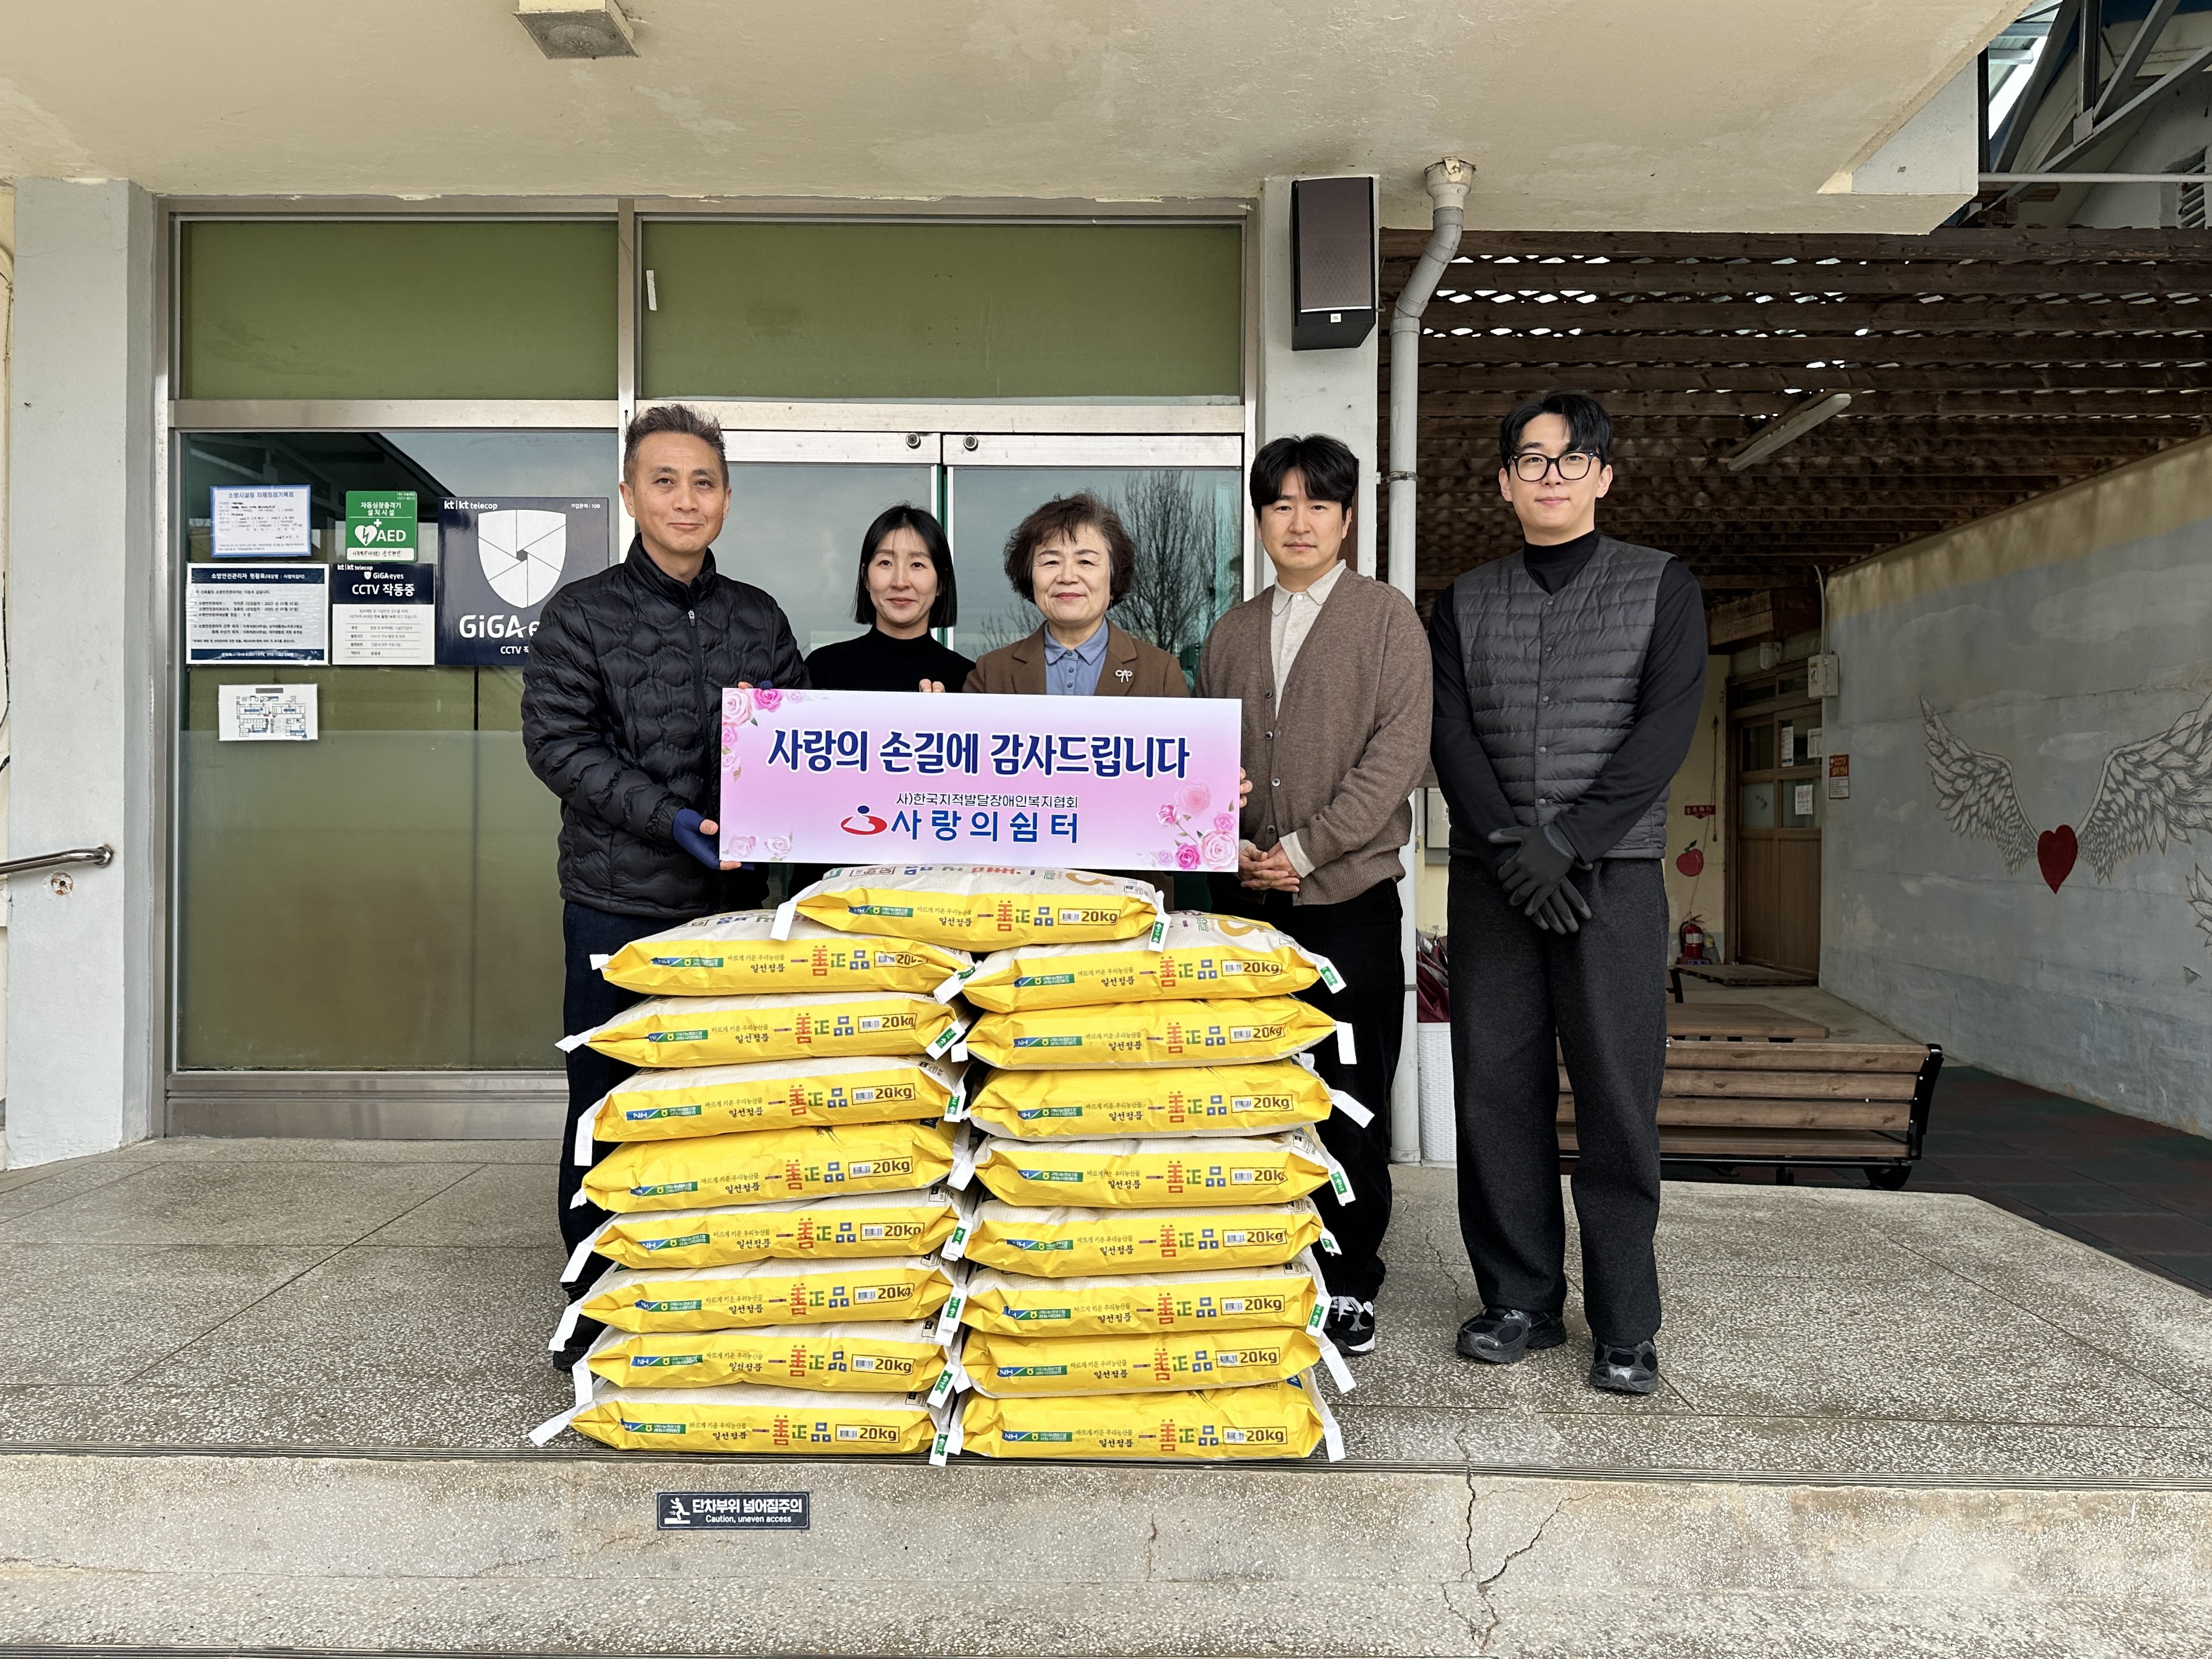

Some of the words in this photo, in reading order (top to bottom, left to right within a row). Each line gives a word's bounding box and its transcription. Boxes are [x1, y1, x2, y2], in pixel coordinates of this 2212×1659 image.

[444, 501, 454, 509] kt
[459, 501, 469, 509] kt
[470, 501, 498, 510] telecop
[376, 529, 406, 542] AED
[352, 584, 379, 595] CCTV
[382, 584, 415, 596] 작동중
[459, 614, 527, 638] GiGA
[528, 621, 540, 637] e
[500, 646, 522, 654] CCTV
[768, 729, 868, 772] 사랑의
[880, 731, 978, 774] 손길에
[991, 734, 1190, 779] 감사드립니다
[895, 793, 1078, 809] 사)한국지적발달장애인복지협회
[939, 917, 972, 927] 일선정품
[1082, 911, 1117, 925] 20kg
[751, 964, 786, 973] 일선정품
[1243, 962, 1279, 973] 20kg
[1101, 976, 1135, 987] 일선정품
[1253, 1027, 1282, 1038] 20kg
[735, 1034, 769, 1044] 일선정품
[1109, 1041, 1142, 1051] 일선정품
[875, 1088, 912, 1099] 20kg
[1254, 1097, 1290, 1109] 20kg
[729, 1106, 763, 1118] 일선정품
[1109, 1111, 1142, 1122] 일선정품
[873, 1161, 909, 1174] 20kg
[1254, 1169, 1285, 1182] 20k
[725, 1182, 760, 1194] 일선정품
[1108, 1180, 1141, 1190] 일선정품
[1247, 1231, 1283, 1243] 20kg
[737, 1239, 771, 1249] 일선정품
[1100, 1246, 1134, 1256] 일선정품
[728, 1303, 764, 1314] 일선정품
[1245, 1298, 1282, 1310] 20kg
[1098, 1313, 1132, 1324] 일선정품
[1240, 1351, 1278, 1363] 20kg
[729, 1362, 763, 1372] 일선정품
[875, 1358, 912, 1373] 20kg
[1093, 1369, 1128, 1379] 일선정품
[712, 1432, 748, 1440] 일선정품
[859, 1428, 896, 1441] 20kg
[1246, 1430, 1284, 1443] 20kg
[1099, 1439, 1134, 1448] 일선정품
[692, 1499, 740, 1513] 단차부위
[743, 1499, 802, 1513] 넘어짐주의
[705, 1515, 736, 1524] Caution,
